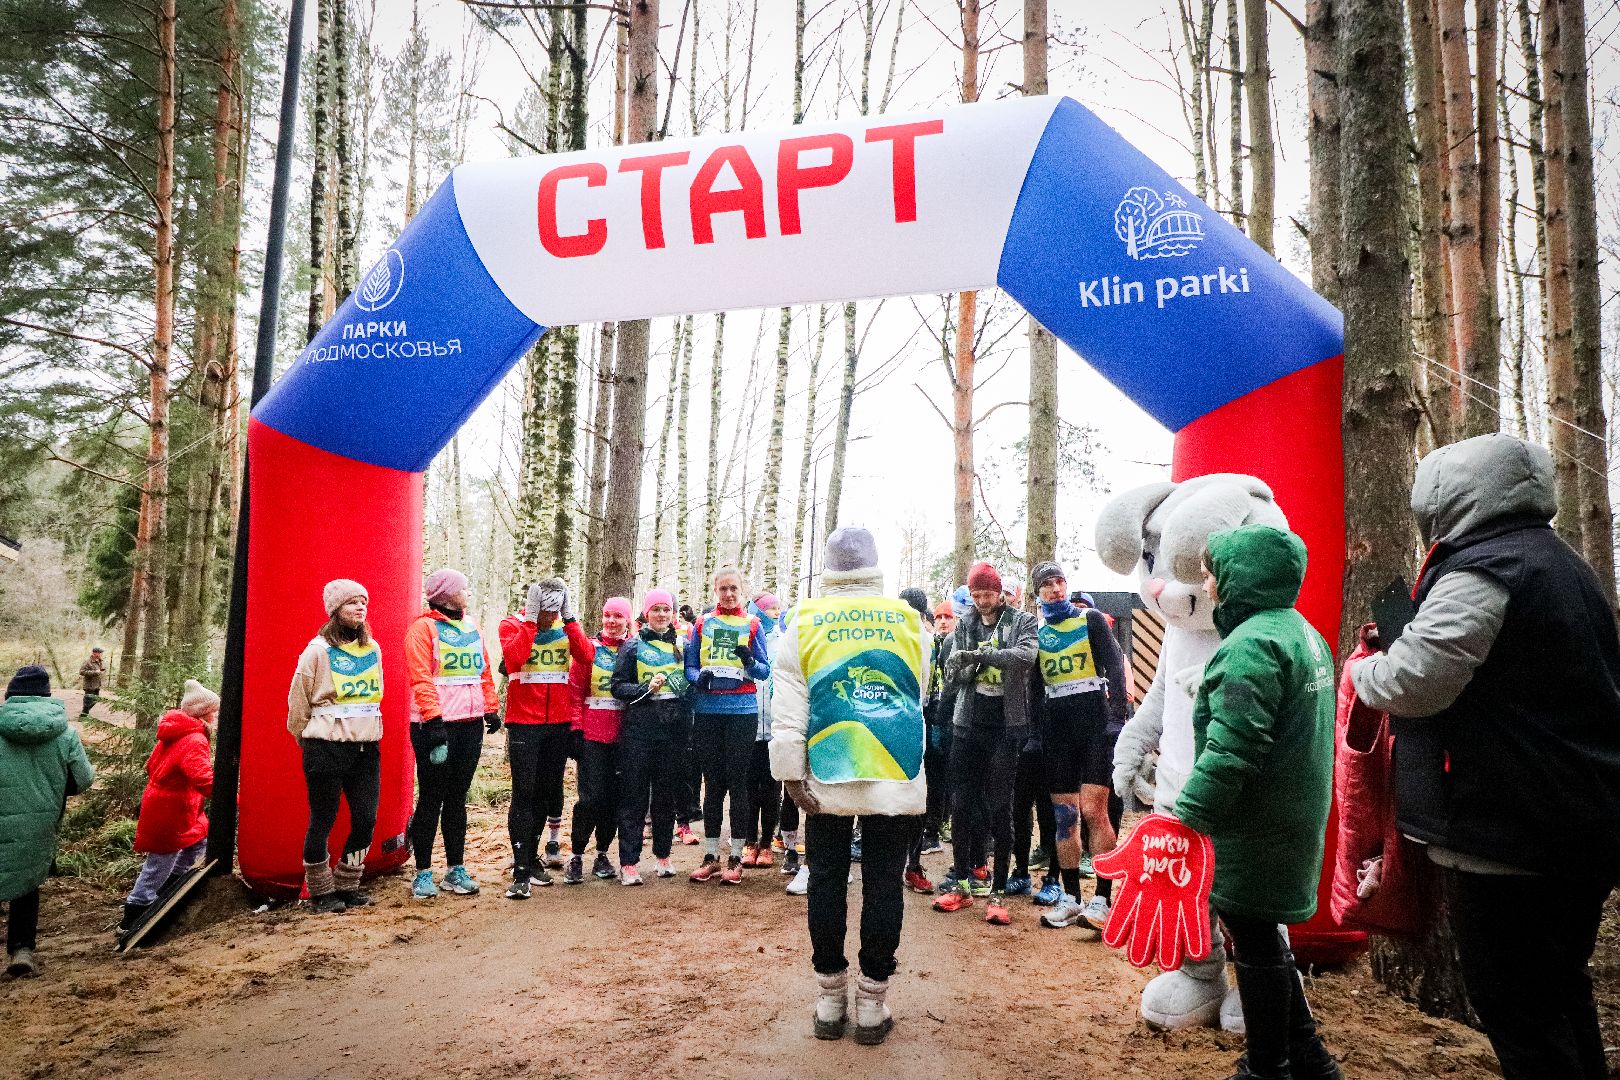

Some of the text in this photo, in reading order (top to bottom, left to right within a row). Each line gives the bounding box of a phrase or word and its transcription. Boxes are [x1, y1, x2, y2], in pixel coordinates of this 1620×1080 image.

[538, 119, 943, 259] СТАРТ
[1078, 266, 1250, 309] Klin parki
[342, 320, 408, 340] ПАРКИ
[305, 339, 463, 365] ПОДМОСКОВЬЯ
[813, 609, 906, 627] ВОЛОНТЕР
[827, 628, 896, 643] СПОРТА
[444, 652, 483, 669] 200
[526, 648, 568, 665] 203
[1045, 652, 1088, 677] 207
[853, 689, 888, 699] СПОРТ
[1139, 853, 1192, 888] Дай
